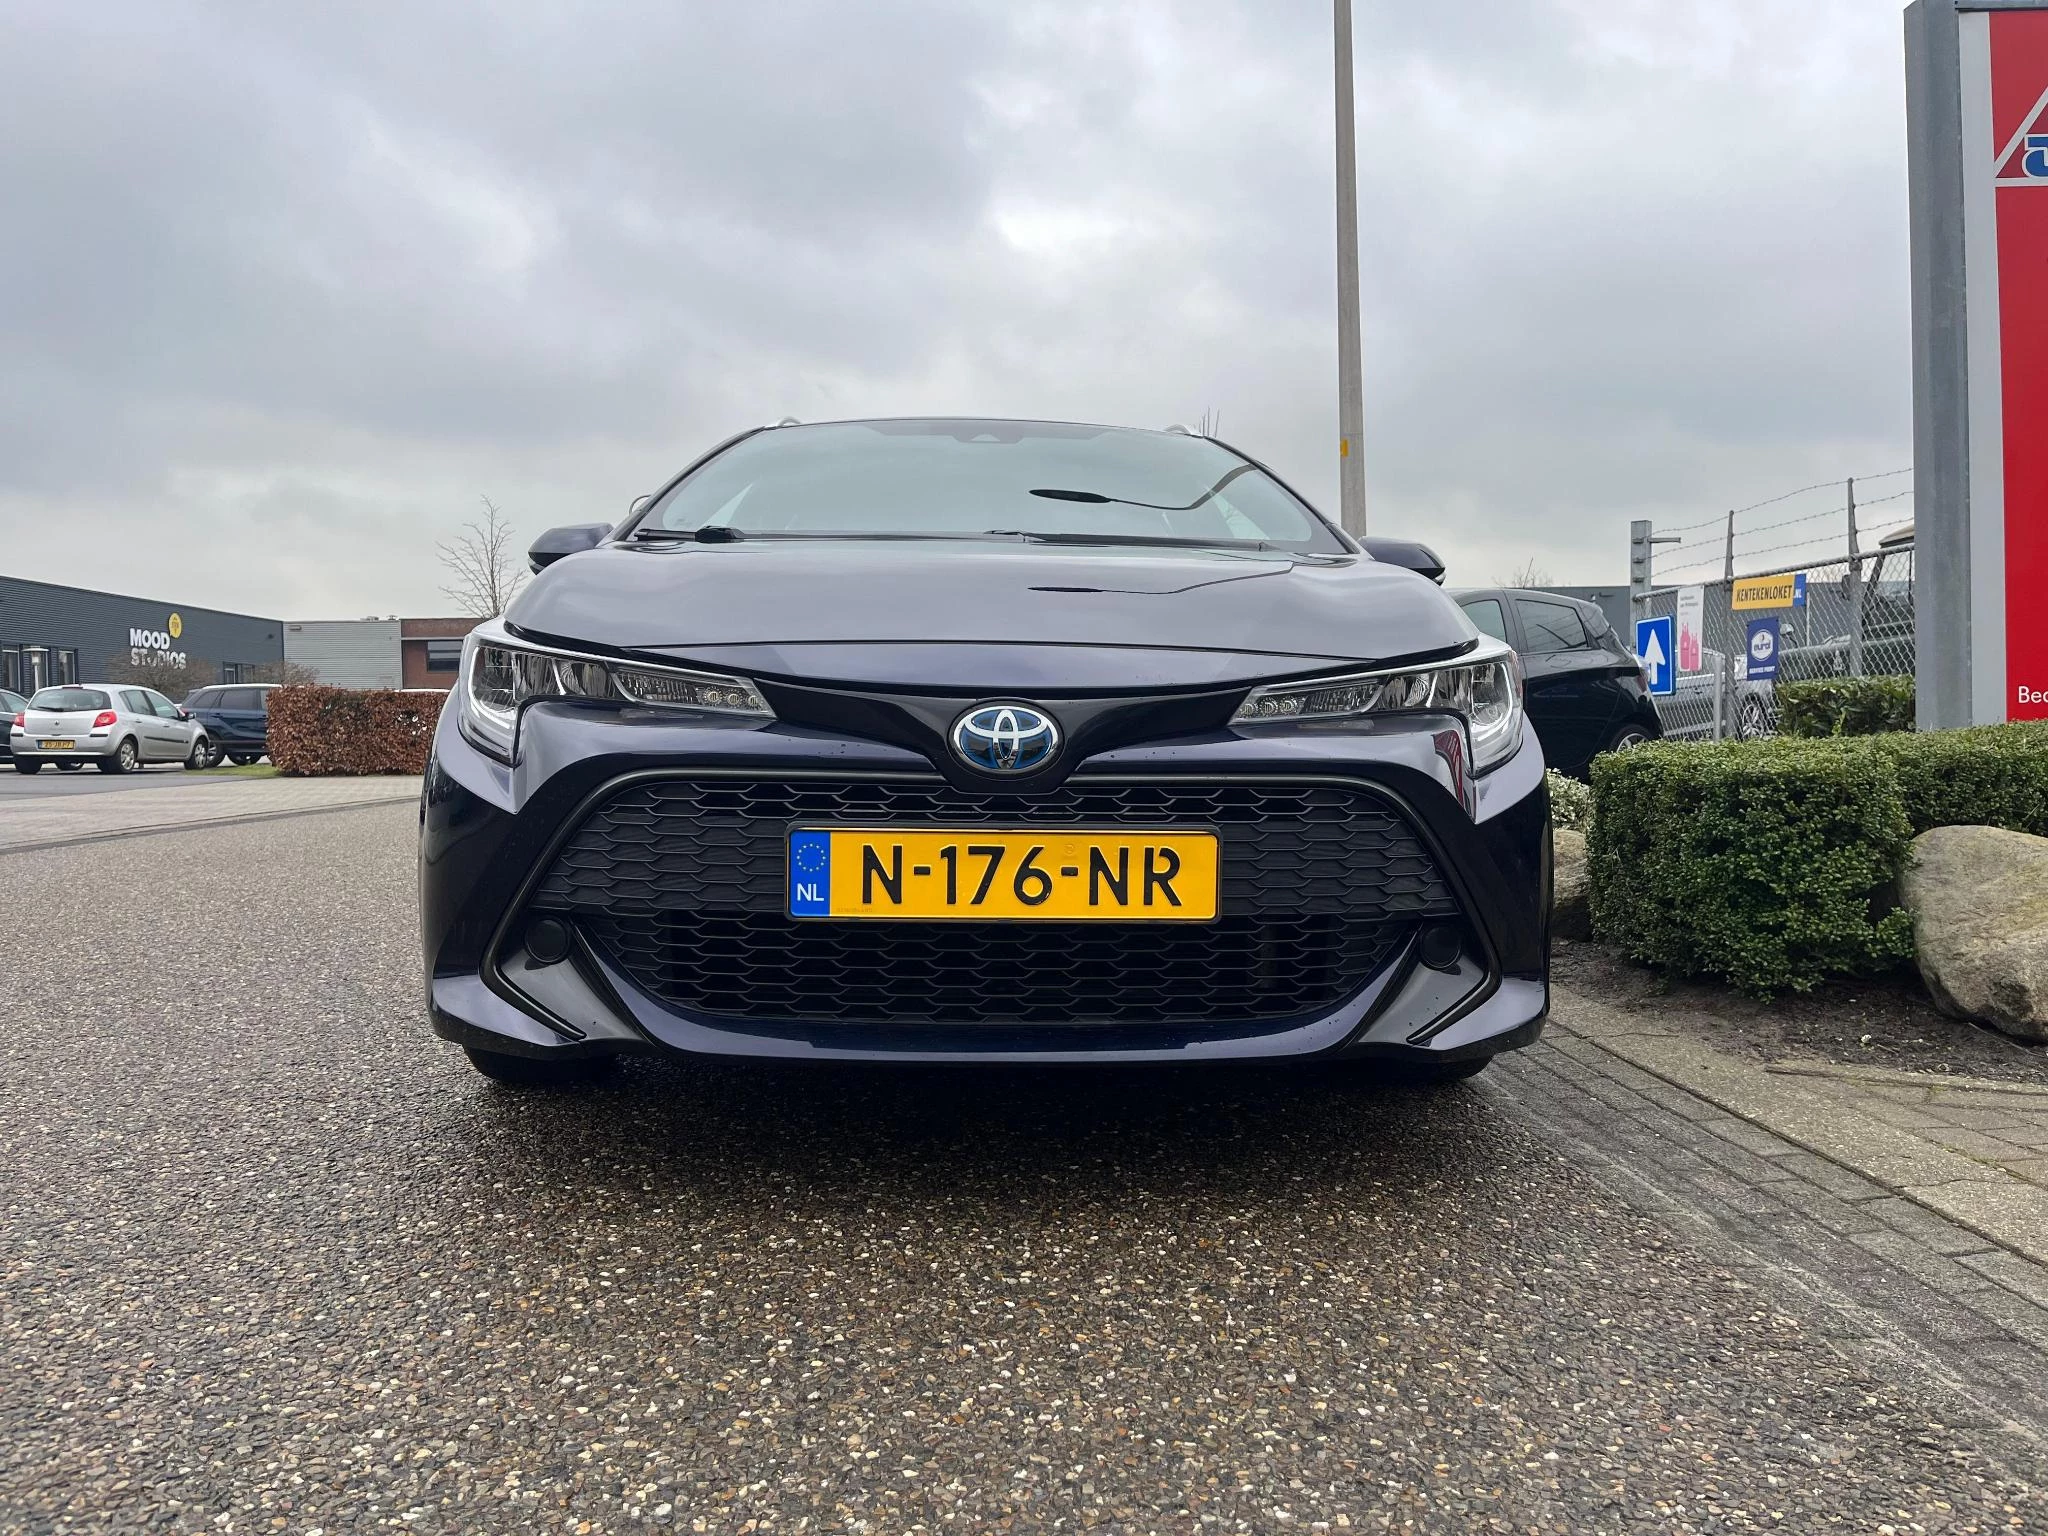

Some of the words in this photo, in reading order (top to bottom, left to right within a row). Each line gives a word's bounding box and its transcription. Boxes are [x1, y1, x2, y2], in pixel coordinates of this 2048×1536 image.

[1736, 585, 1792, 602] KENTEKENLOKET
[130, 627, 170, 650] MOOD
[862, 844, 1182, 906] N-176-NR
[797, 883, 825, 902] NL
